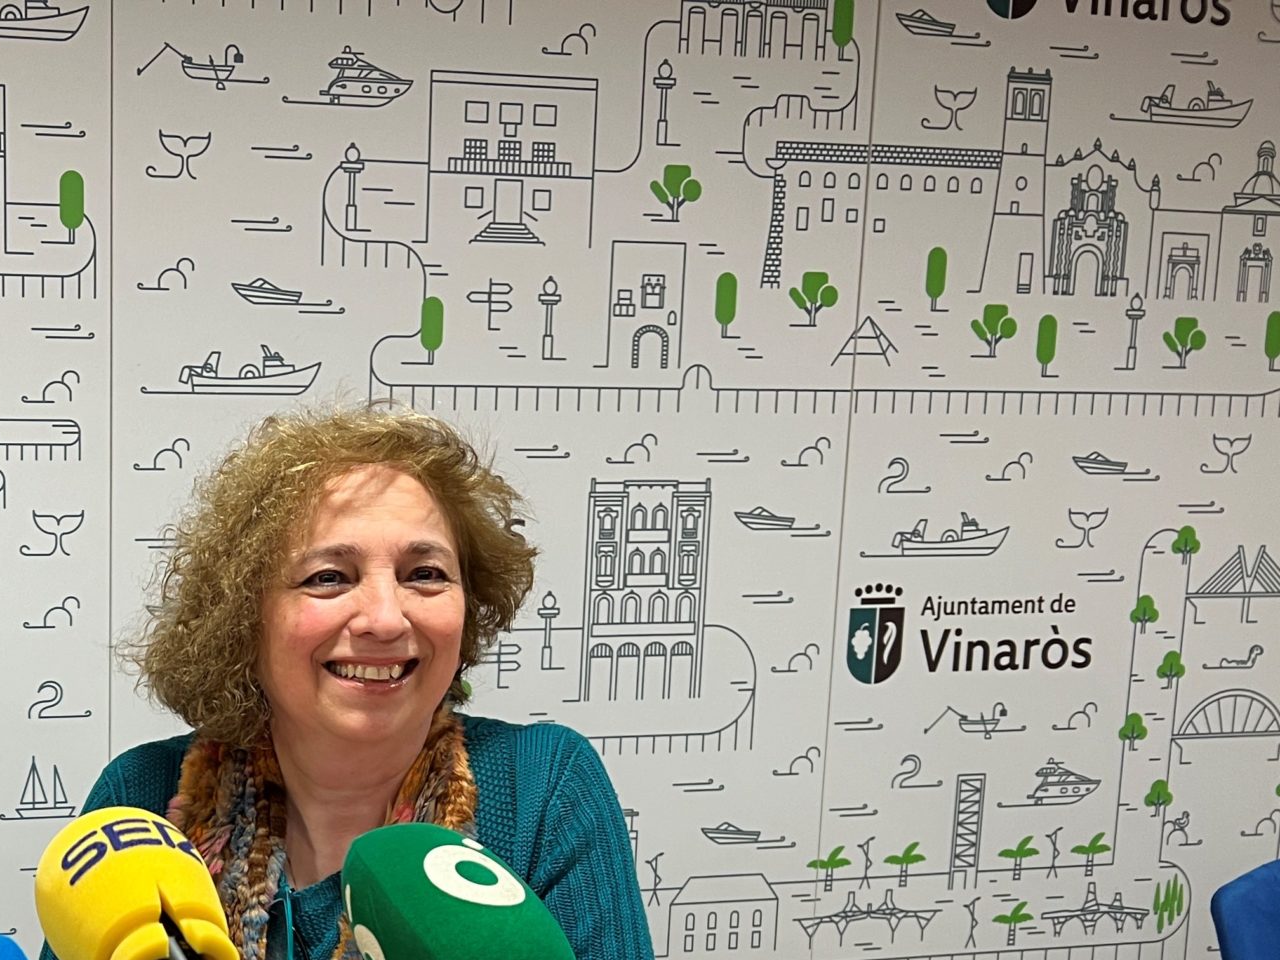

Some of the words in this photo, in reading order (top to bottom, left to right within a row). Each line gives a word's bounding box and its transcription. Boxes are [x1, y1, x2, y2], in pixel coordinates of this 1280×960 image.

[921, 595, 1045, 621] Ajuntament
[1050, 593, 1076, 613] de
[920, 625, 1092, 672] Vinaròs
